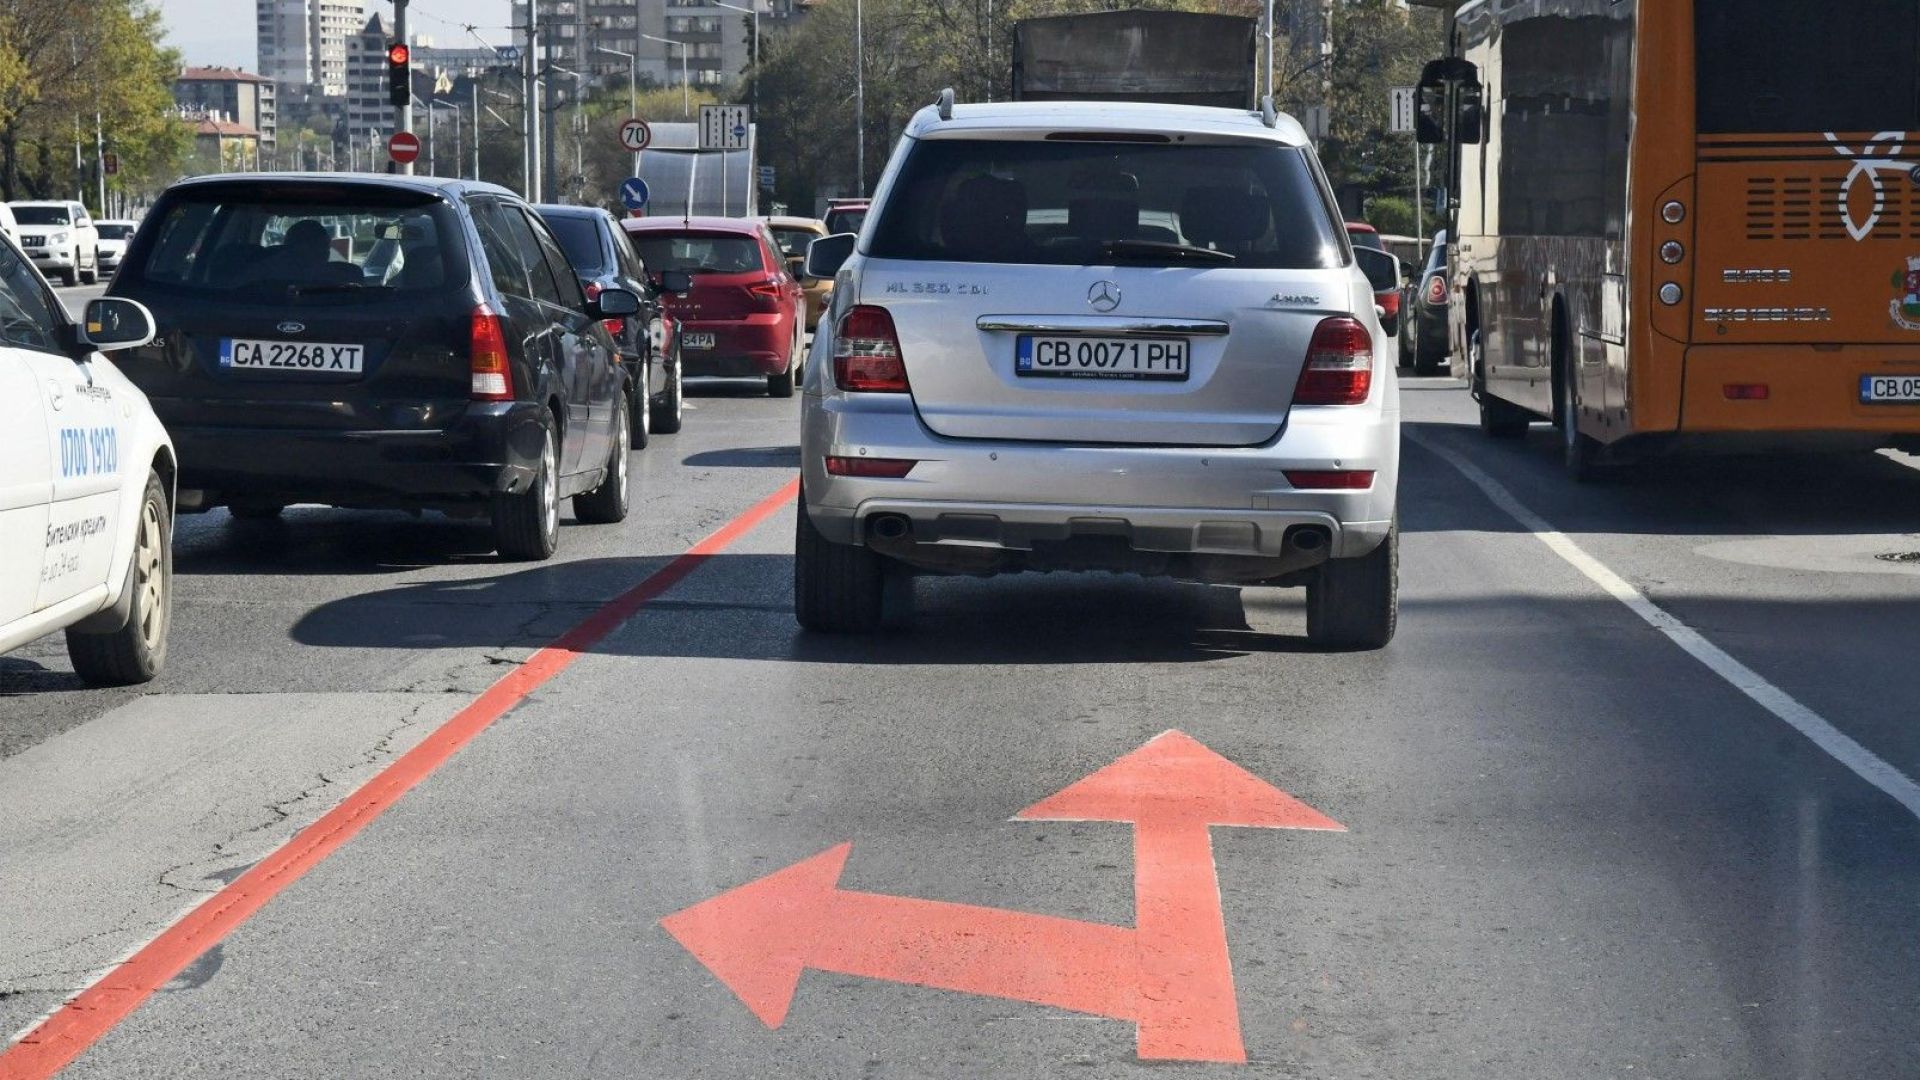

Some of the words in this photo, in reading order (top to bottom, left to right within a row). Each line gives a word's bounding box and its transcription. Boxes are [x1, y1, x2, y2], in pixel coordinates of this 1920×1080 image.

[626, 127, 645, 144] 70
[233, 343, 264, 366] CA
[269, 344, 325, 369] 2268
[330, 347, 360, 370] XT
[1036, 341, 1072, 367] CB
[1077, 342, 1139, 369] 0071
[1147, 343, 1183, 370] PH
[1873, 379, 1898, 397] CB
[60, 427, 88, 478] 0700
[90, 426, 118, 475] 19120
